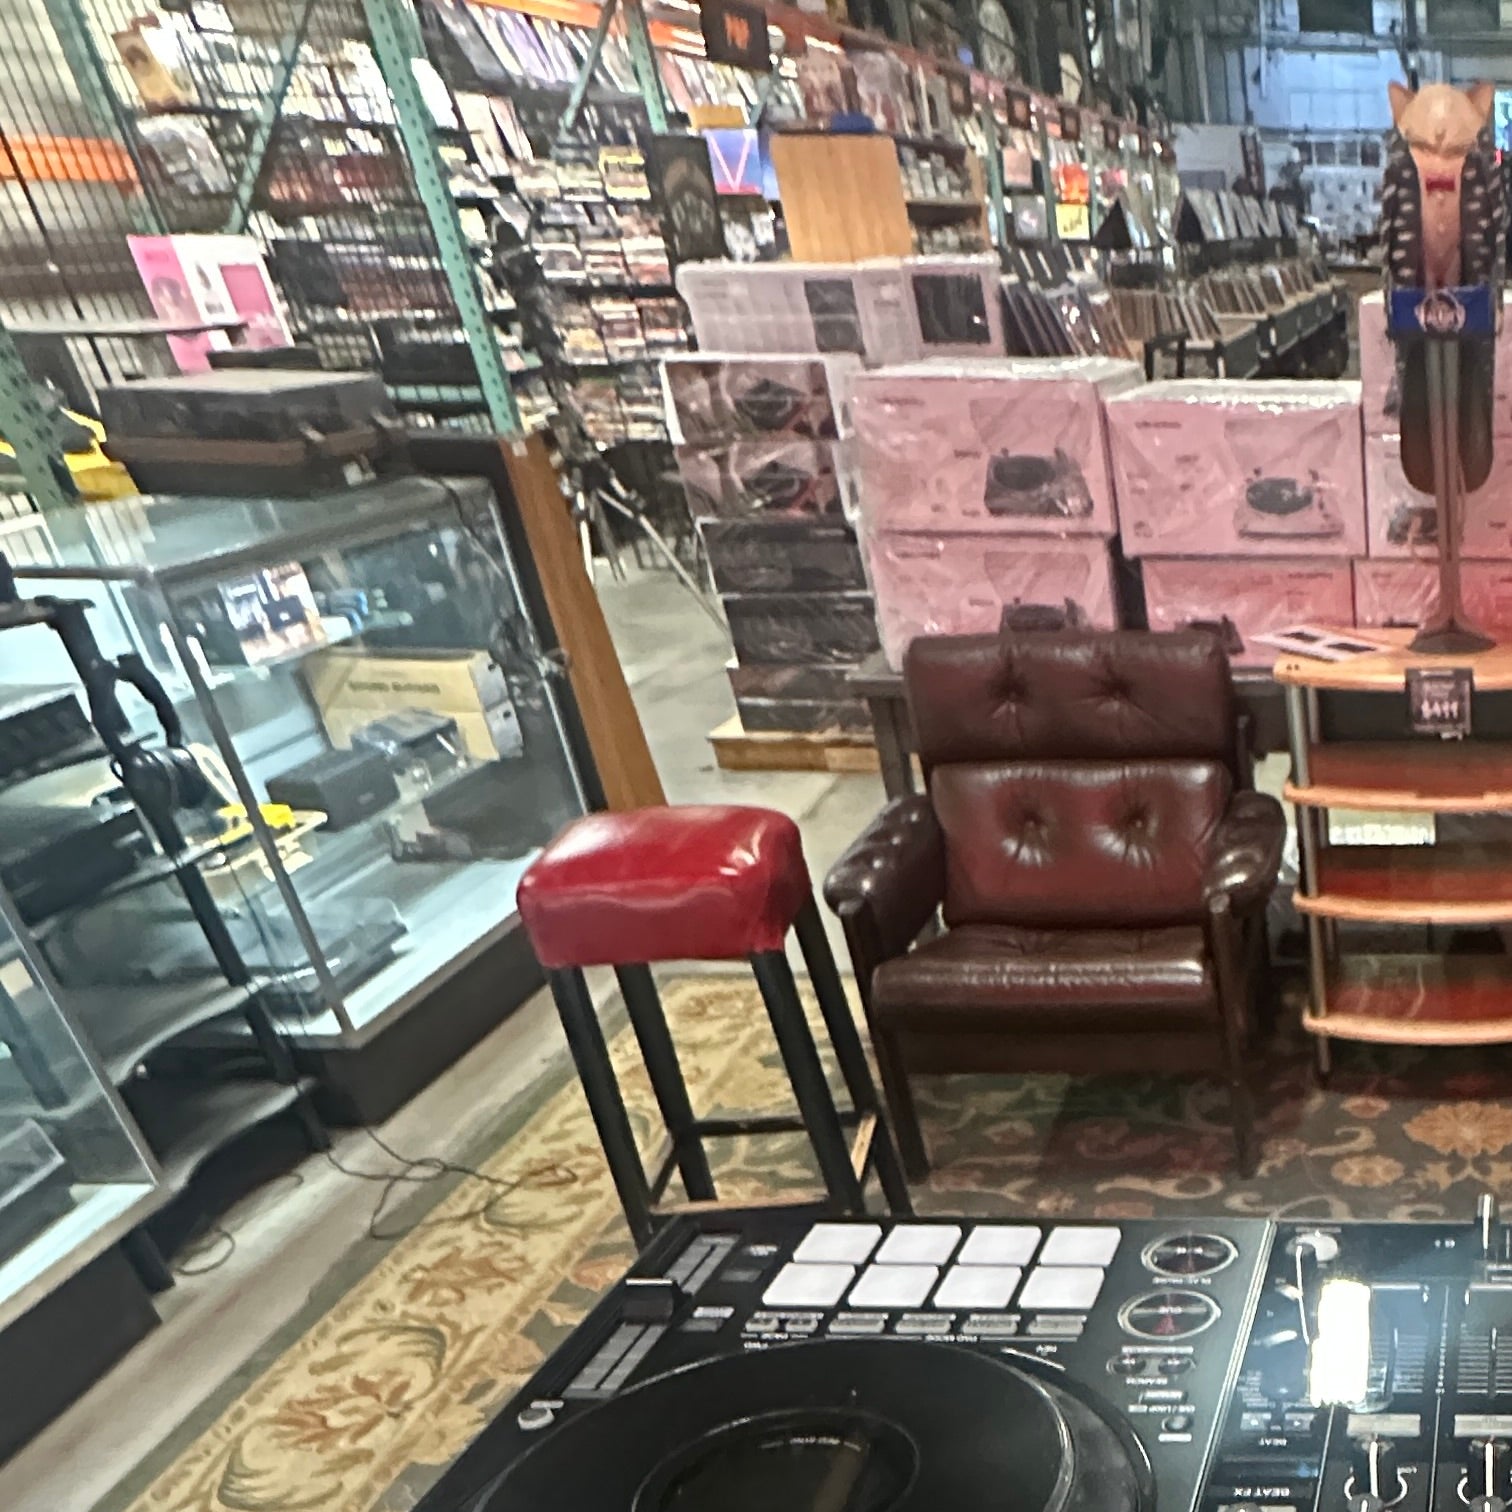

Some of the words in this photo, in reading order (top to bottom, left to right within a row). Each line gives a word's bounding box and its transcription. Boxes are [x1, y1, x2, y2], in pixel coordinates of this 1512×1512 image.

[1258, 1438, 1287, 1446] BEAT
[1234, 1487, 1252, 1496] FX
[1256, 1487, 1290, 1496] BEAT
